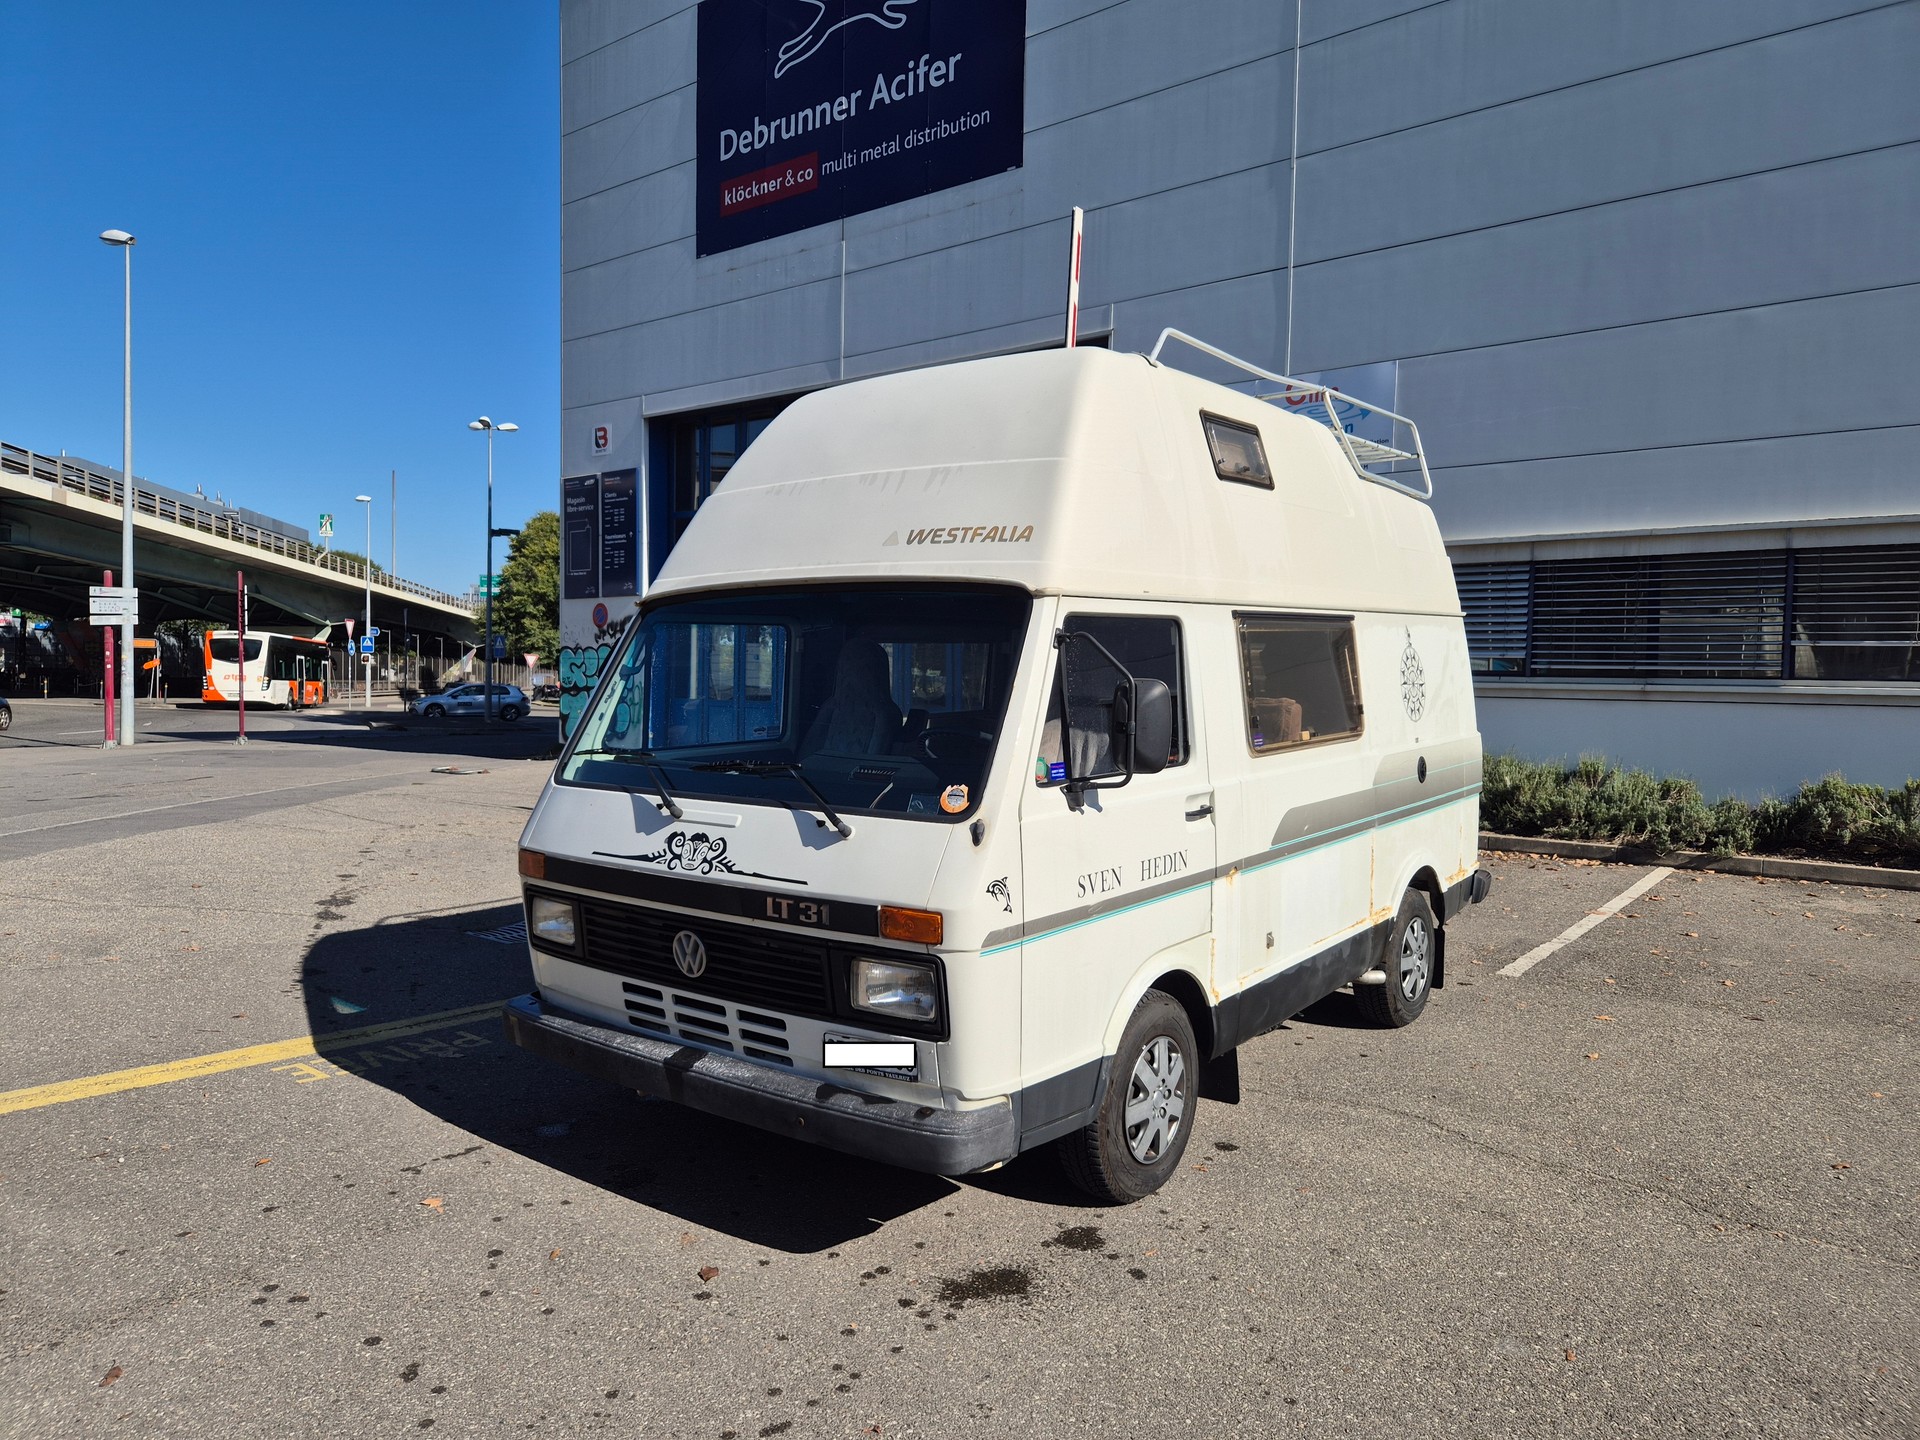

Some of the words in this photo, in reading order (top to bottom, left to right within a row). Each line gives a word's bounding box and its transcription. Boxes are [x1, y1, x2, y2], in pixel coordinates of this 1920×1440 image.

[720, 89, 862, 161] Debrunner
[868, 53, 962, 111] Acifer
[821, 150, 857, 176] multi
[860, 135, 900, 163] metal
[904, 110, 990, 149] distribution
[724, 175, 783, 206] klöckner
[566, 497, 586, 505] Magasin
[566, 504, 594, 513] libre-service
[906, 525, 1034, 546] WESTFALIA
[1077, 866, 1122, 899] SVEN
[1140, 849, 1188, 882] HEDIN
[766, 896, 794, 920] LT
[799, 901, 830, 926] 31
